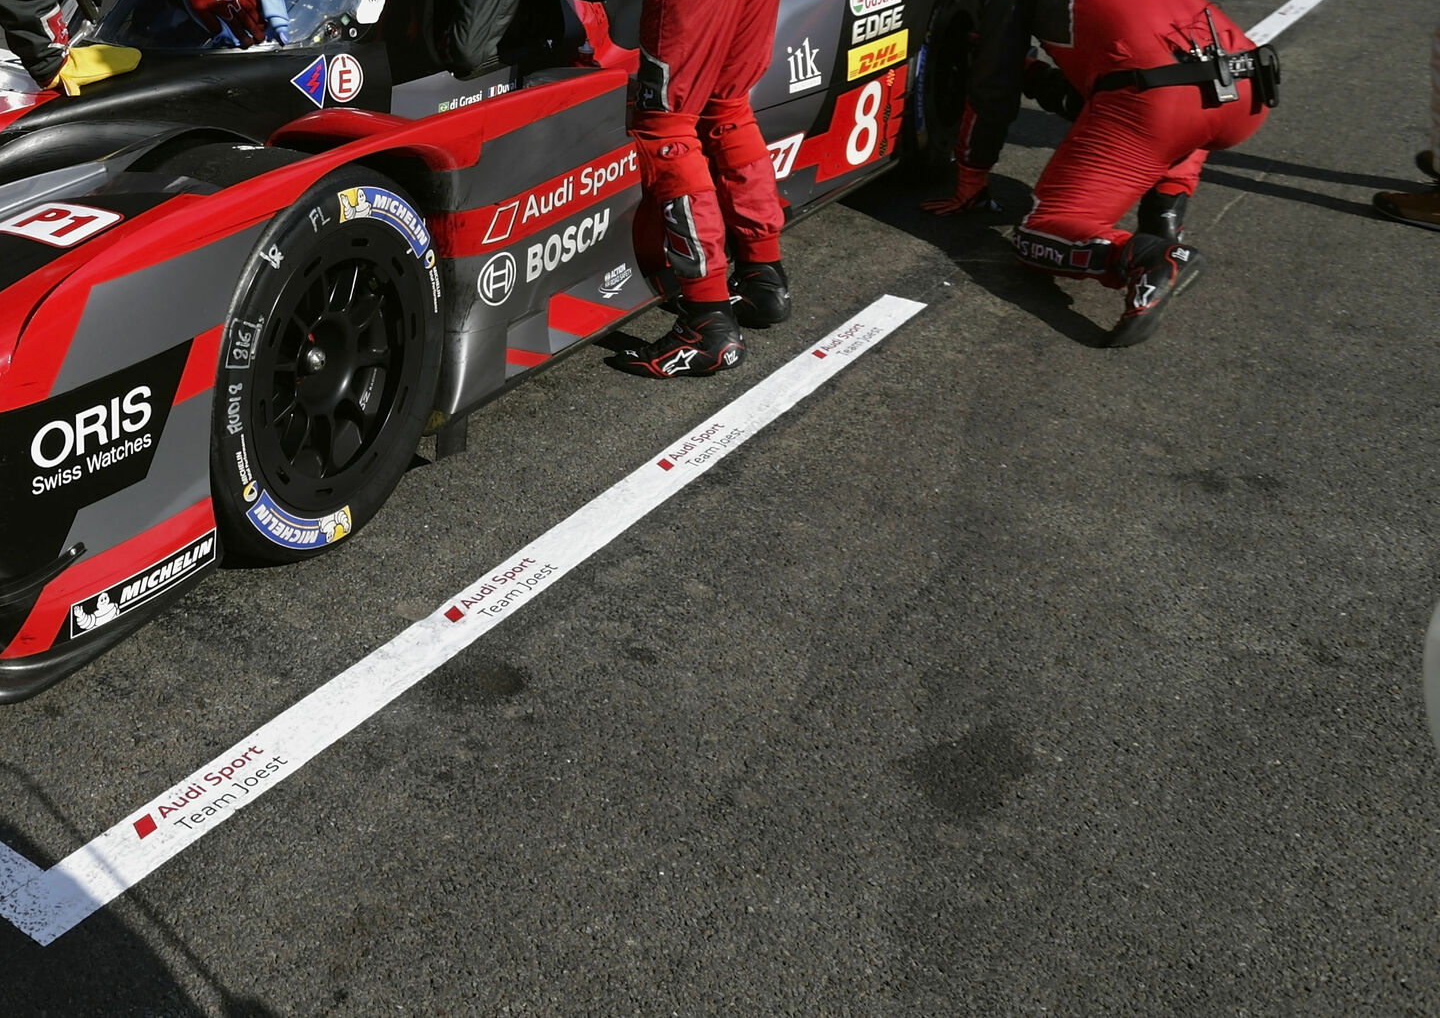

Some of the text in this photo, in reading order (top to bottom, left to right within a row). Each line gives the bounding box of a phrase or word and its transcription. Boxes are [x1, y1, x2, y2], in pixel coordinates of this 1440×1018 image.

[852, 5, 906, 45] EDGE
[787, 37, 822, 83] itk
[858, 43, 898, 74] DHL
[338, 69, 352, 94] E
[450, 98, 459, 111] di
[459, 90, 483, 107] Grassi
[846, 80, 882, 165] 8
[522, 150, 637, 224] Audi Sport
[11, 208, 99, 238] P1
[373, 193, 428, 248] MICHELIN
[526, 208, 610, 283] BOSCH
[432, 266, 442, 297] MICHELIN
[821, 322, 865, 353] Audi Sport
[836, 326, 884, 357] Team Joest
[31, 385, 152, 468] ORIS
[669, 422, 725, 462] Audi Sport
[685, 427, 746, 469] Team Joest
[32, 433, 152, 495] Swiss Watches
[235, 451, 248, 485] MICHELIN
[254, 504, 320, 544] MICHELIN
[119, 538, 213, 604] MICHELIN
[460, 557, 536, 609] Audi Sport
[477, 563, 558, 618] Team Joest
[158, 745, 264, 819] Audi Sport
[173, 755, 289, 830] Team Joest
